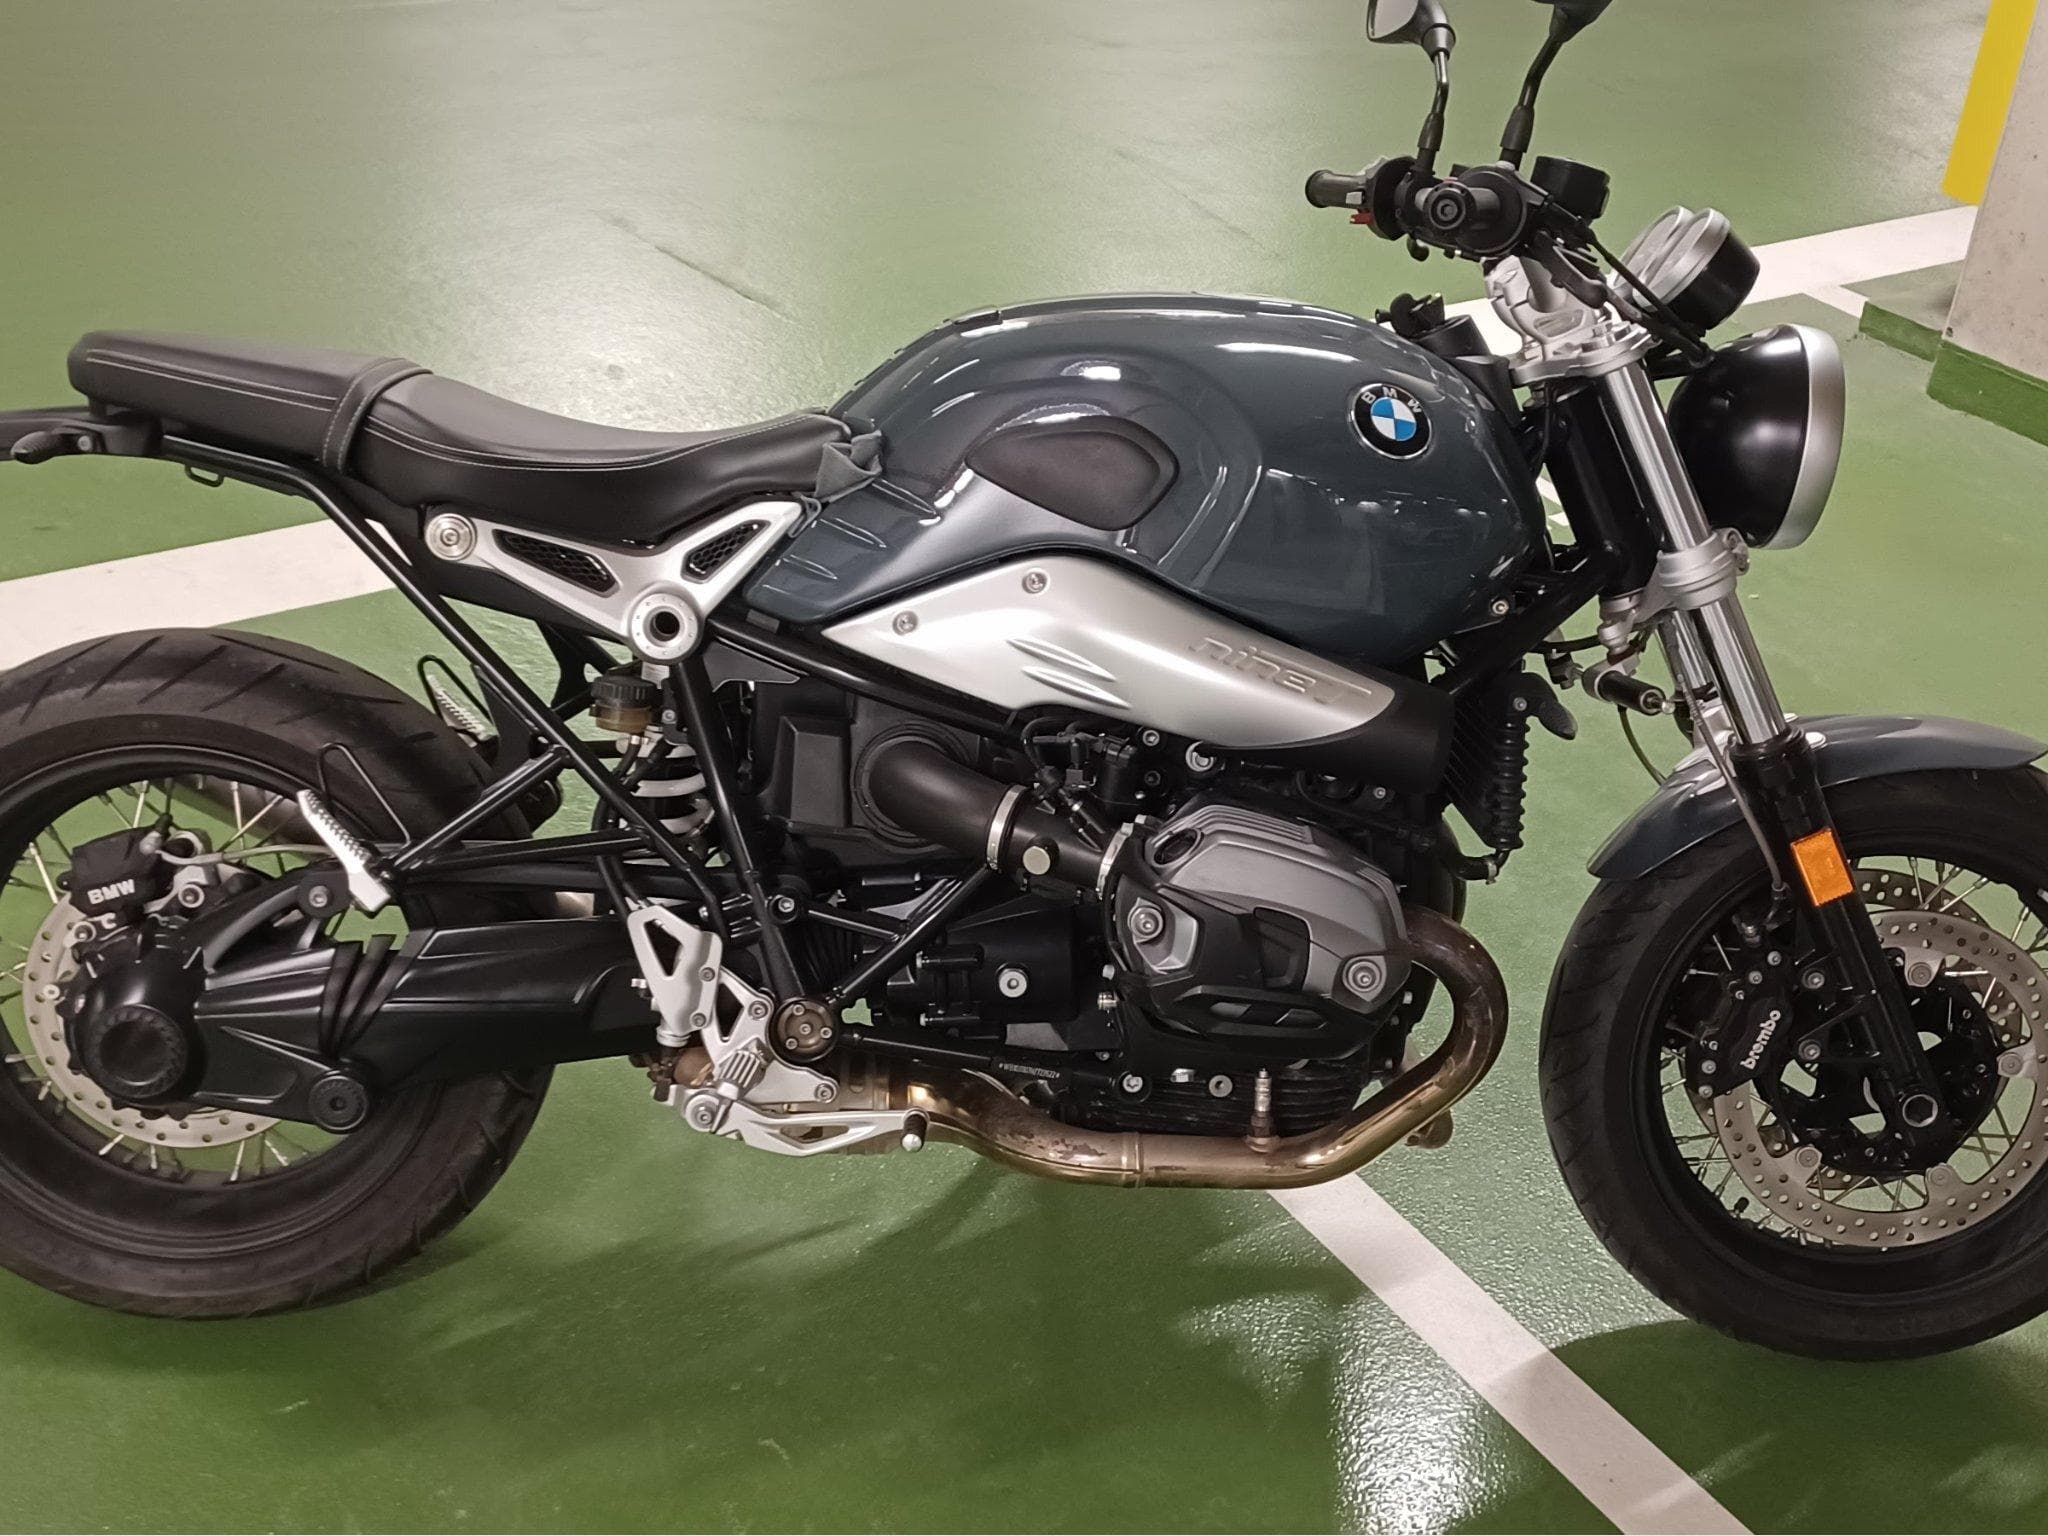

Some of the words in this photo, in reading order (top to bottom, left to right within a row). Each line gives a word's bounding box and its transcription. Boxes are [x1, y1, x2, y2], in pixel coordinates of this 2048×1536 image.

[1361, 386, 1422, 413] BMW
[87, 879, 136, 905] BMW
[1739, 1009, 1782, 1070] brembo
